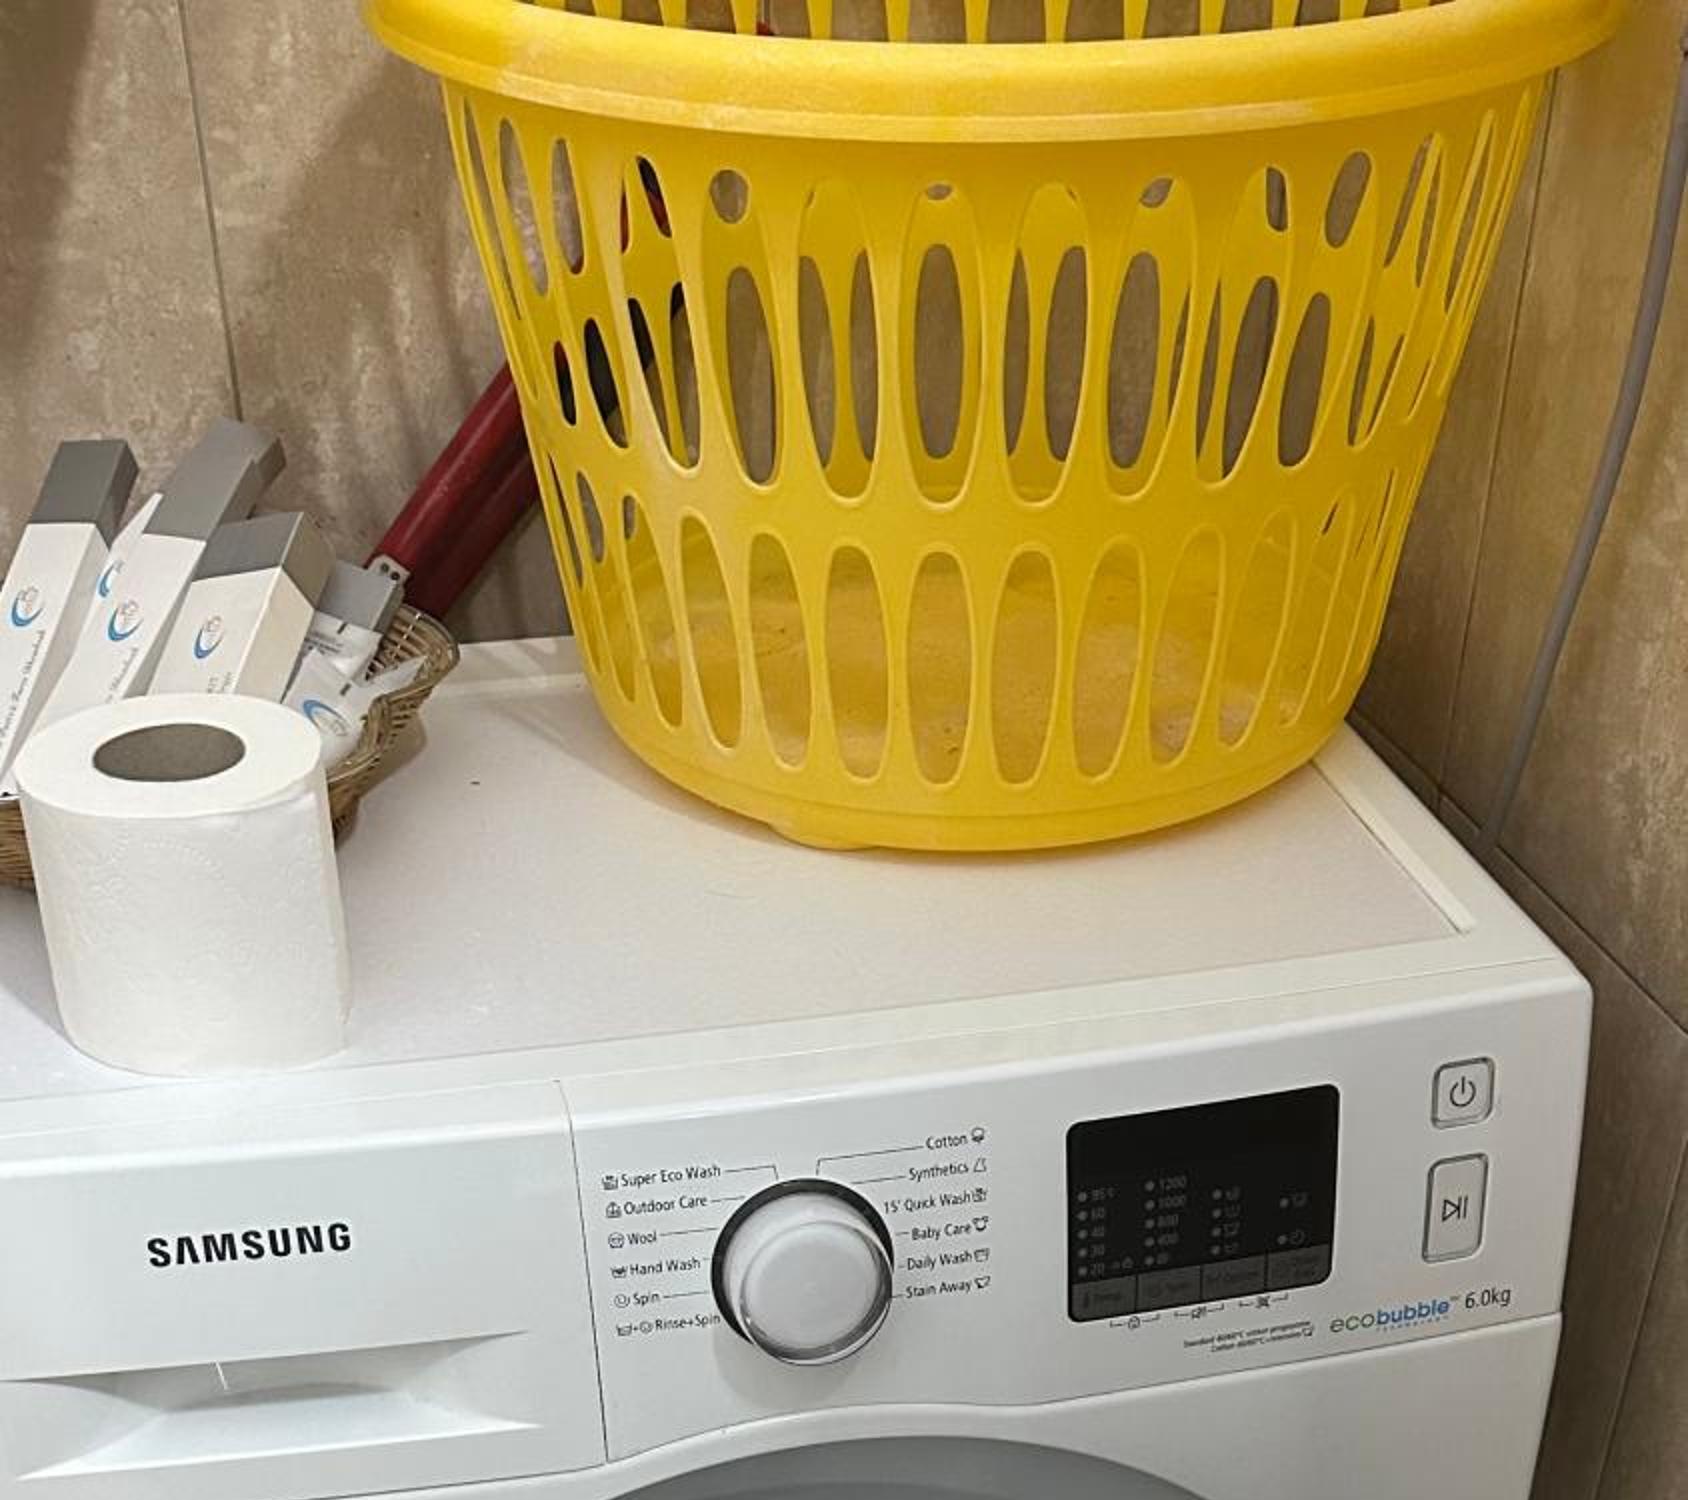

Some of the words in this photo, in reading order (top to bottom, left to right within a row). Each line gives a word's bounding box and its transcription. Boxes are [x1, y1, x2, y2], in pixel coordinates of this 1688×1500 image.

[926, 1134, 968, 1150] Cotton
[621, 1172, 656, 1189] Super
[660, 1169, 683, 1183] Eco
[686, 1162, 721, 1179] Wash
[909, 1163, 969, 1182] Synthetics
[623, 1198, 676, 1215] Outdoor
[679, 1194, 708, 1209] Care
[904, 1194, 936, 1212] Quick
[940, 1190, 971, 1206] Wash
[627, 1229, 657, 1245] Wool
[911, 1226, 940, 1241] Baby
[944, 1223, 972, 1237] Care
[147, 1222, 351, 1268] SAMSUNG
[629, 1260, 663, 1276] Hand
[666, 1256, 701, 1272] Wash
[907, 1255, 937, 1272] Daily
[940, 1250, 972, 1266] Wash
[633, 1291, 660, 1307] Spin
[906, 1284, 937, 1299] Stain
[940, 1281, 971, 1294] Away
[1330, 1299, 1450, 1333] ecobubble
[1465, 1286, 1512, 1309] 6.0kg
[655, 1313, 721, 1331] Rinse+Spin
